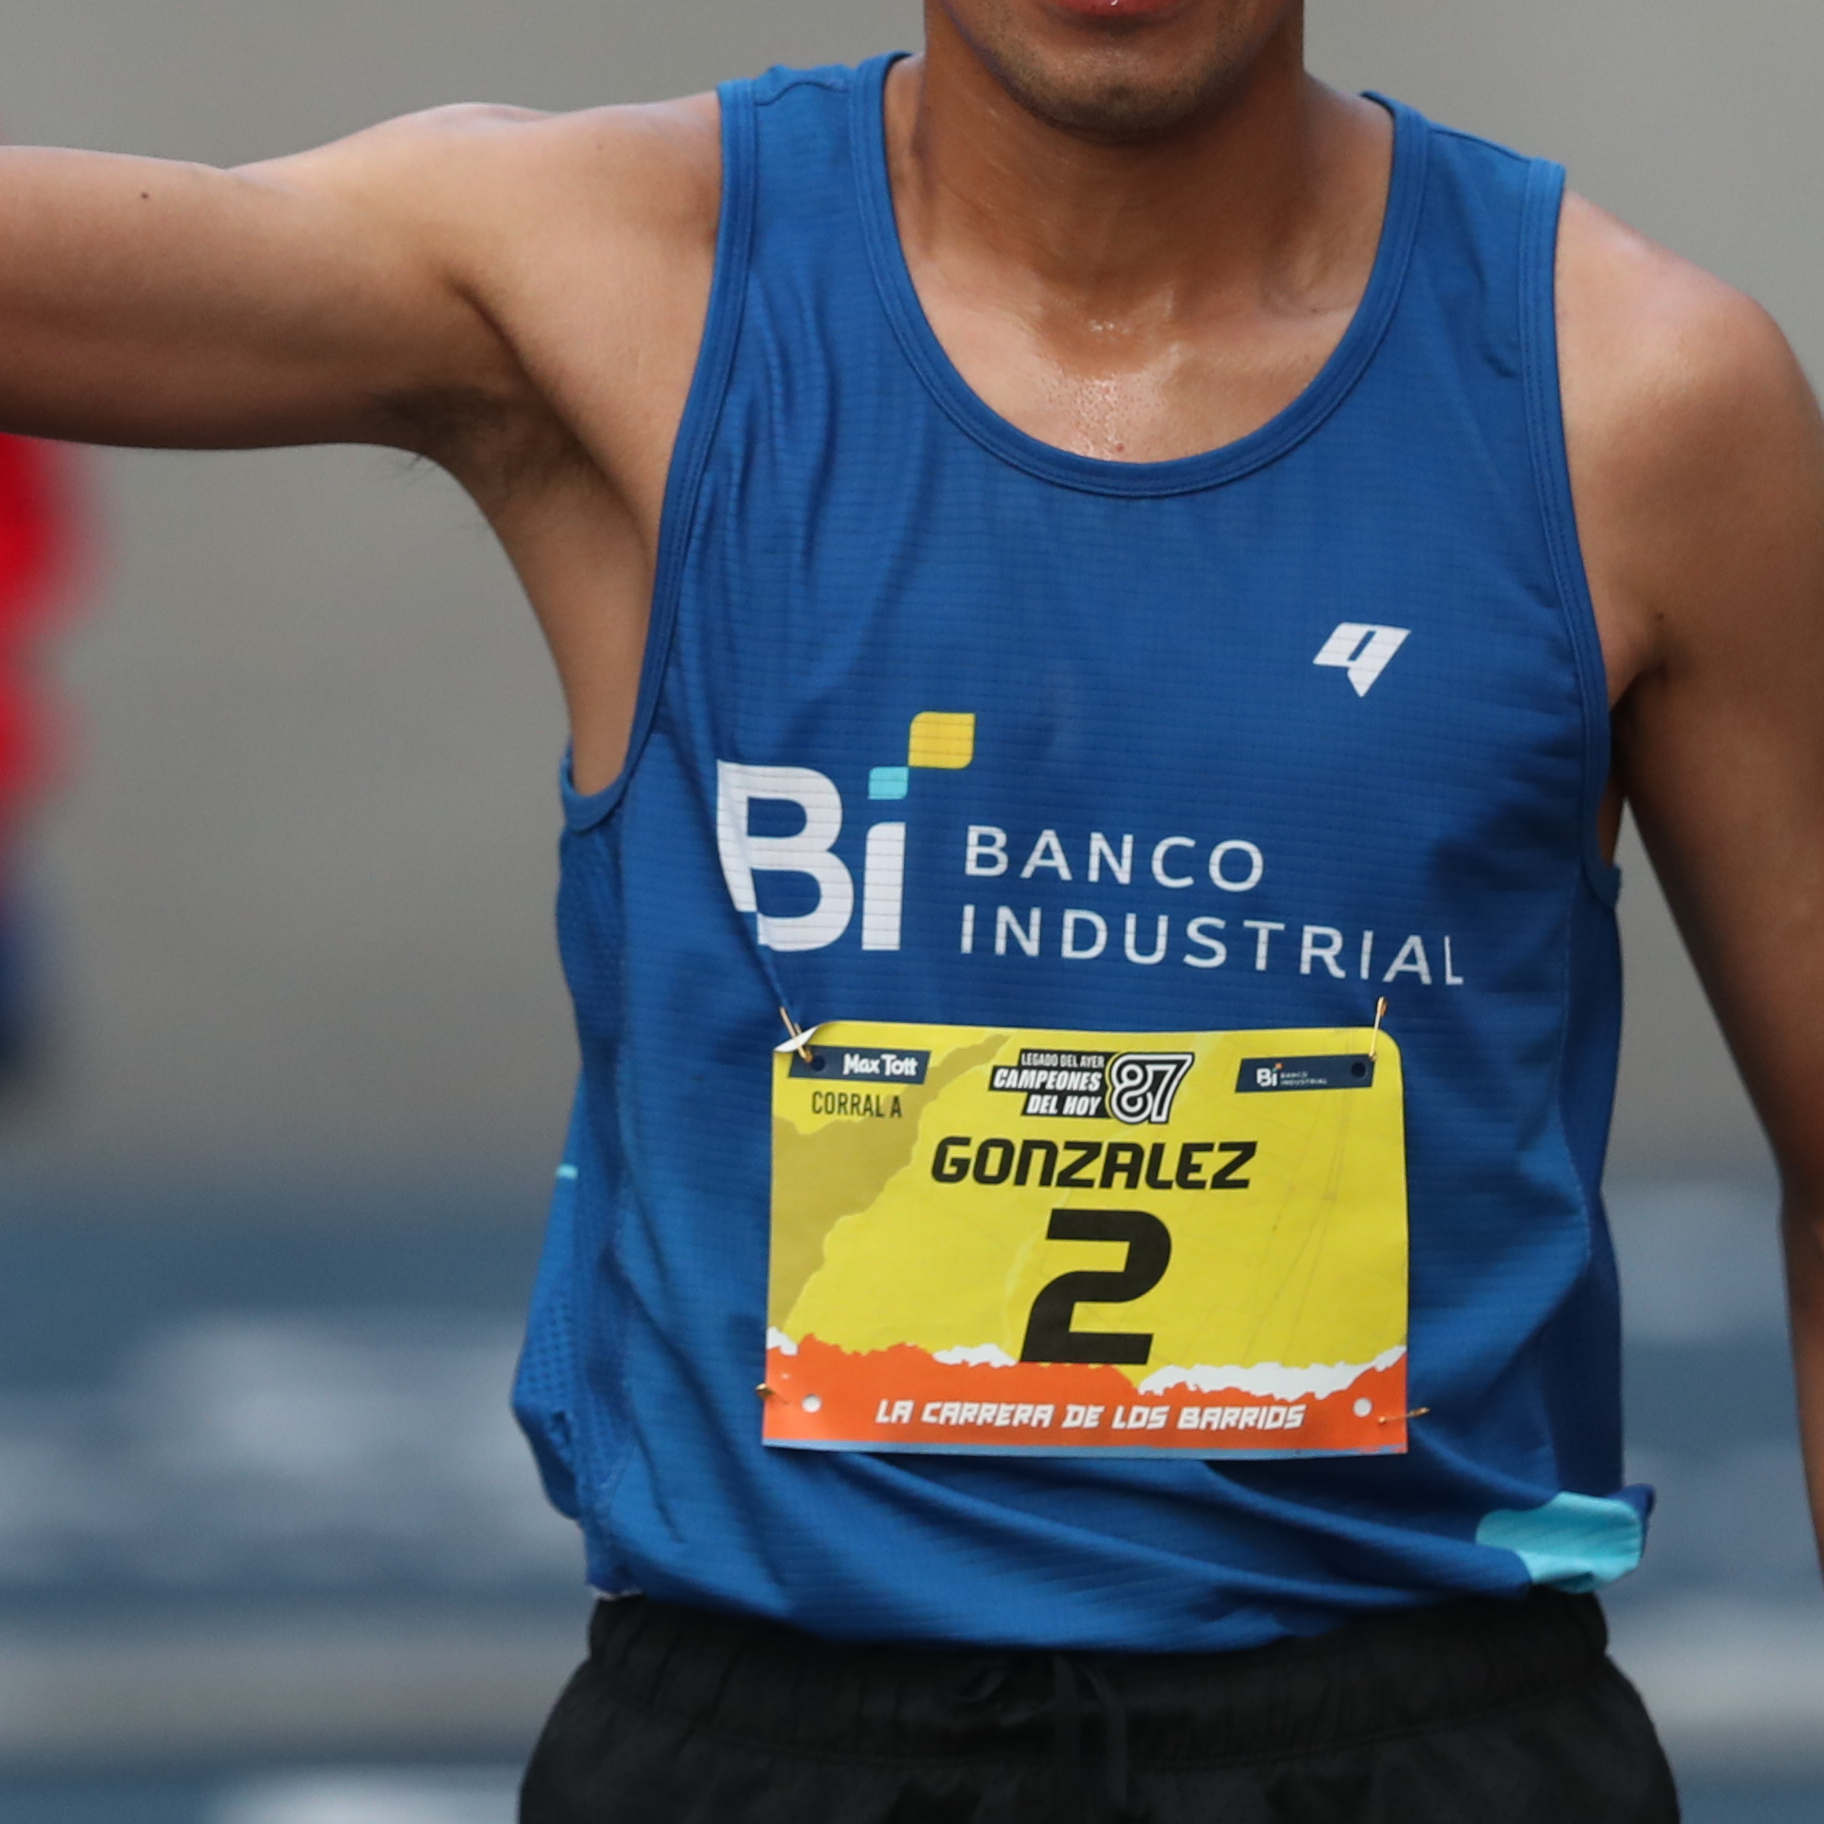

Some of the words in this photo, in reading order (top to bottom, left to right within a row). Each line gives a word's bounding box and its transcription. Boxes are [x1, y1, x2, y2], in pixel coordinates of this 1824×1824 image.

[717, 758, 909, 953] Bi
[964, 823, 1264, 893] BANCO
[960, 903, 1464, 986] INDUSTRIAL
[842, 1052, 880, 1075] Max
[880, 1053, 918, 1077] Tott
[1020, 1052, 1058, 1067] LEGADO
[1060, 1054, 1078, 1068] DEL
[1079, 1055, 1105, 1069] AYER
[1256, 1065, 1280, 1087] Bi
[993, 1068, 1102, 1092] CAMPEONES
[1110, 1053, 1194, 1124] 87
[811, 1090, 885, 1118] CORRAL
[889, 1094, 902, 1118] A
[1026, 1093, 1059, 1115] DEL
[1062, 1095, 1102, 1116] HOY
[931, 1135, 1258, 1190] GONZALEZ
[1019, 1207, 1172, 1365] 2
[875, 1399, 915, 1424] LA
[920, 1401, 1056, 1428] CARRERA
[1061, 1403, 1105, 1429] DE
[1111, 1405, 1171, 1430] LOS
[1177, 1404, 1307, 1431] BARRIOS
